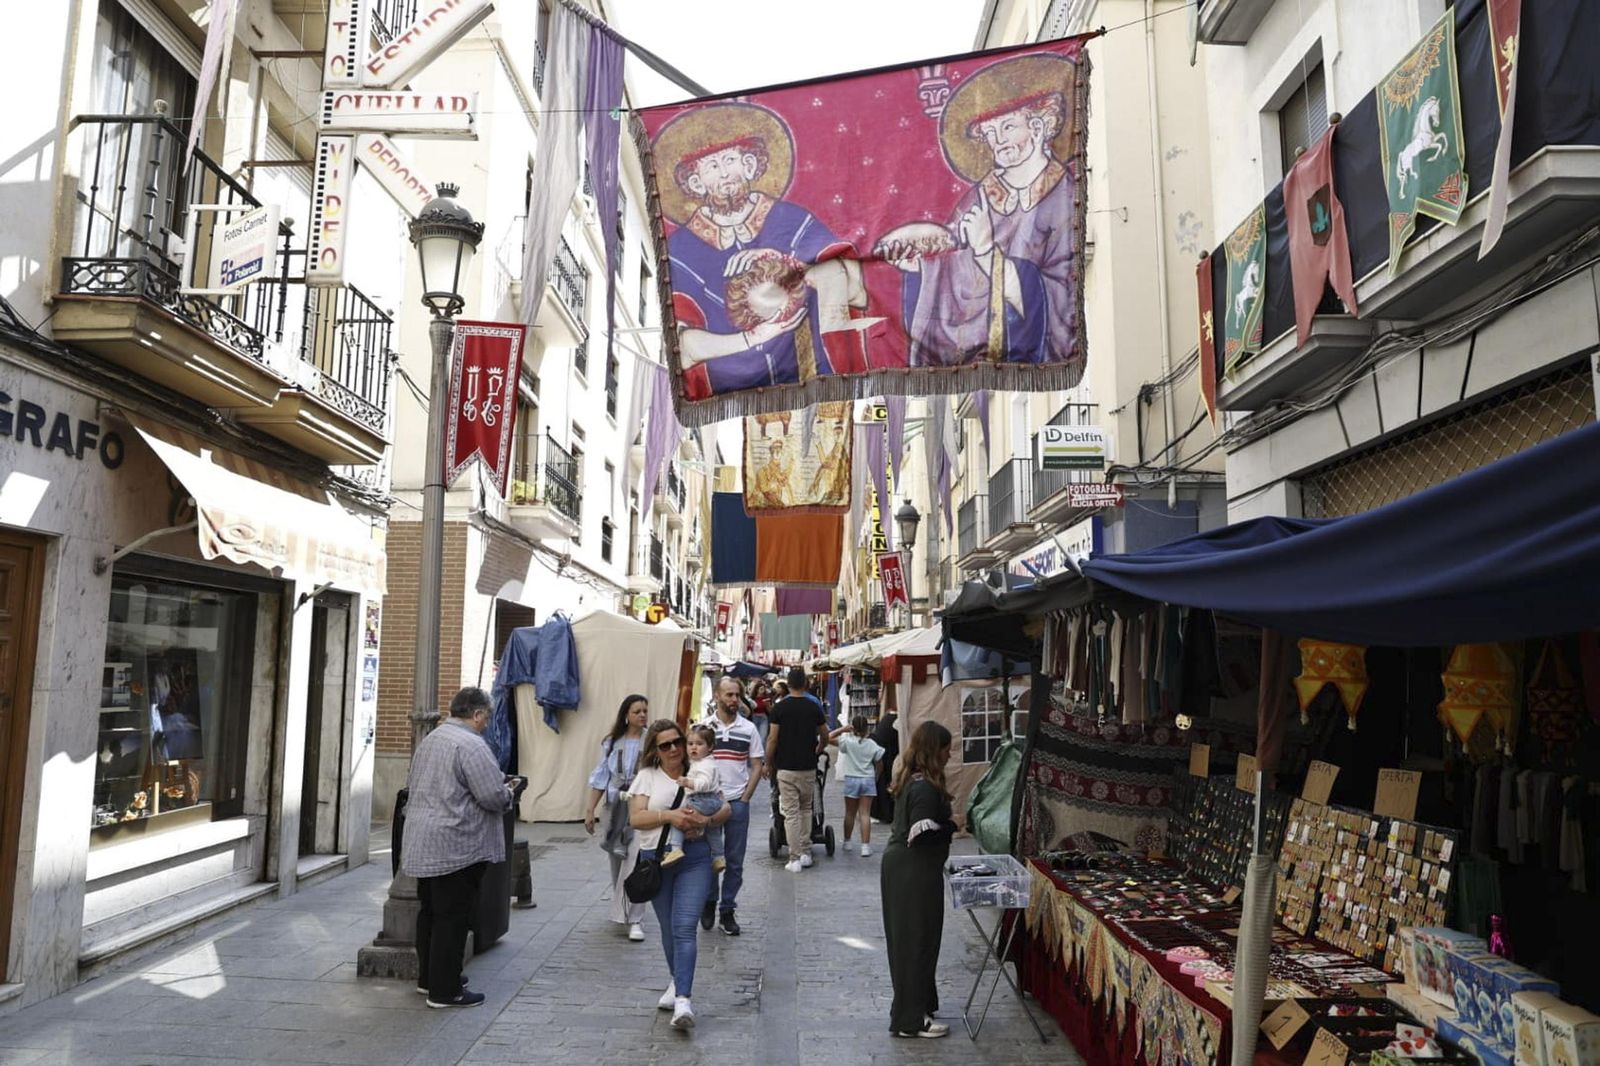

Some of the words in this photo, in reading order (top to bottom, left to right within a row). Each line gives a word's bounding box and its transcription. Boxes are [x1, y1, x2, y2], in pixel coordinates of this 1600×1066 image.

[366, 0, 460, 75] ESTUDI
[320, 143, 345, 269] VIDEO
[223, 226, 243, 242] Fotos
[243, 212, 267, 233] Carnet
[1069, 484, 1116, 494] FOTOGRAFA
[1071, 499, 1094, 507] ALICIA
[1094, 498, 1116, 507] ORTIZ
